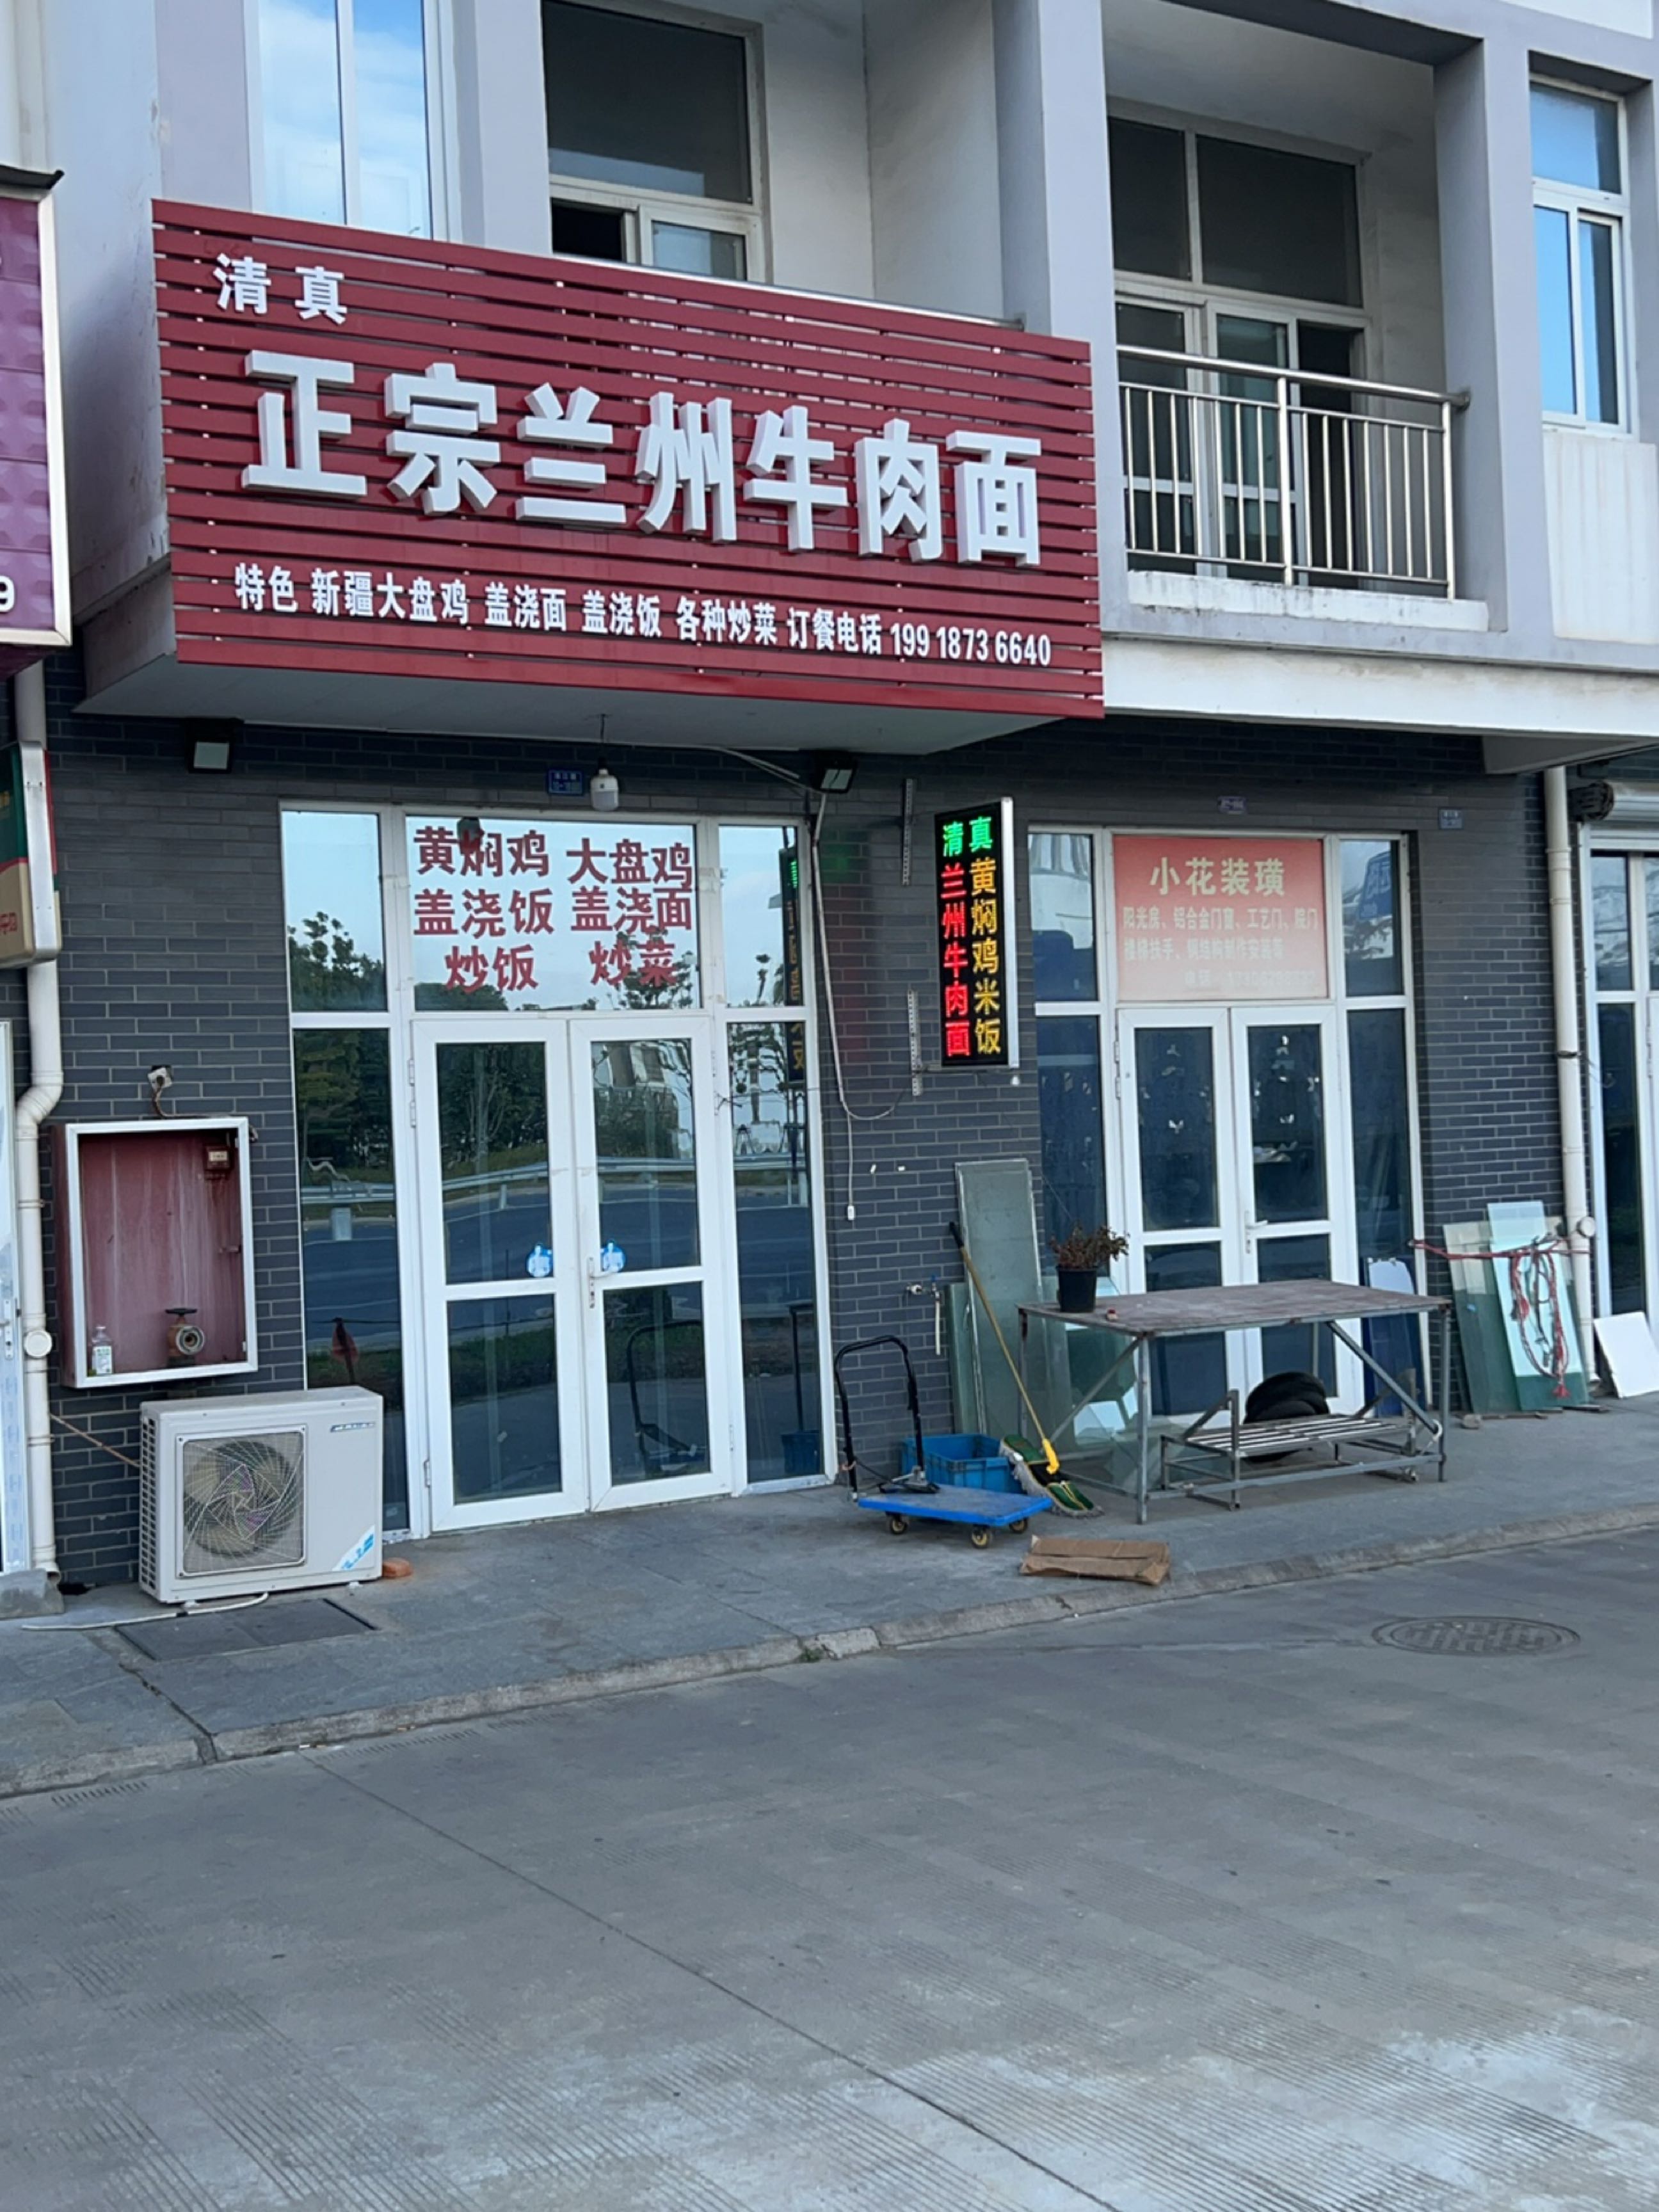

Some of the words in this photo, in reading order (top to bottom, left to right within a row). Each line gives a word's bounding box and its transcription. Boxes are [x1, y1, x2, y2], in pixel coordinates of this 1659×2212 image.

[213, 253, 348, 325] 清真
[241, 349, 1042, 566] 正宗兰州牛肉面
[234, 562, 299, 613] 特色
[310, 567, 469, 625] 新疆大盘鸡
[485, 582, 567, 632] 盖浇面
[582, 589, 662, 638] 盖浇饭
[675, 596, 778, 646] 各种炒菜
[787, 607, 883, 655] 订餐电话
[890, 622, 930, 657] 199
[935, 626, 990, 662] 1873
[995, 630, 1052, 666] 6640
[413, 826, 550, 878] 黄焖鸡
[566, 837, 693, 888] 大盘鸡
[942, 815, 993, 858] 清真
[1150, 856, 1285, 897] 小花装璜
[413, 888, 555, 939] 盖浇饭
[571, 886, 693, 935] 盖浇面
[445, 944, 539, 994] 炒饭
[589, 940, 677, 987] 炒菜
[940, 862, 972, 1057] 兰州牛肉面
[968, 856, 1002, 1055] 黄焖鸡米饭
